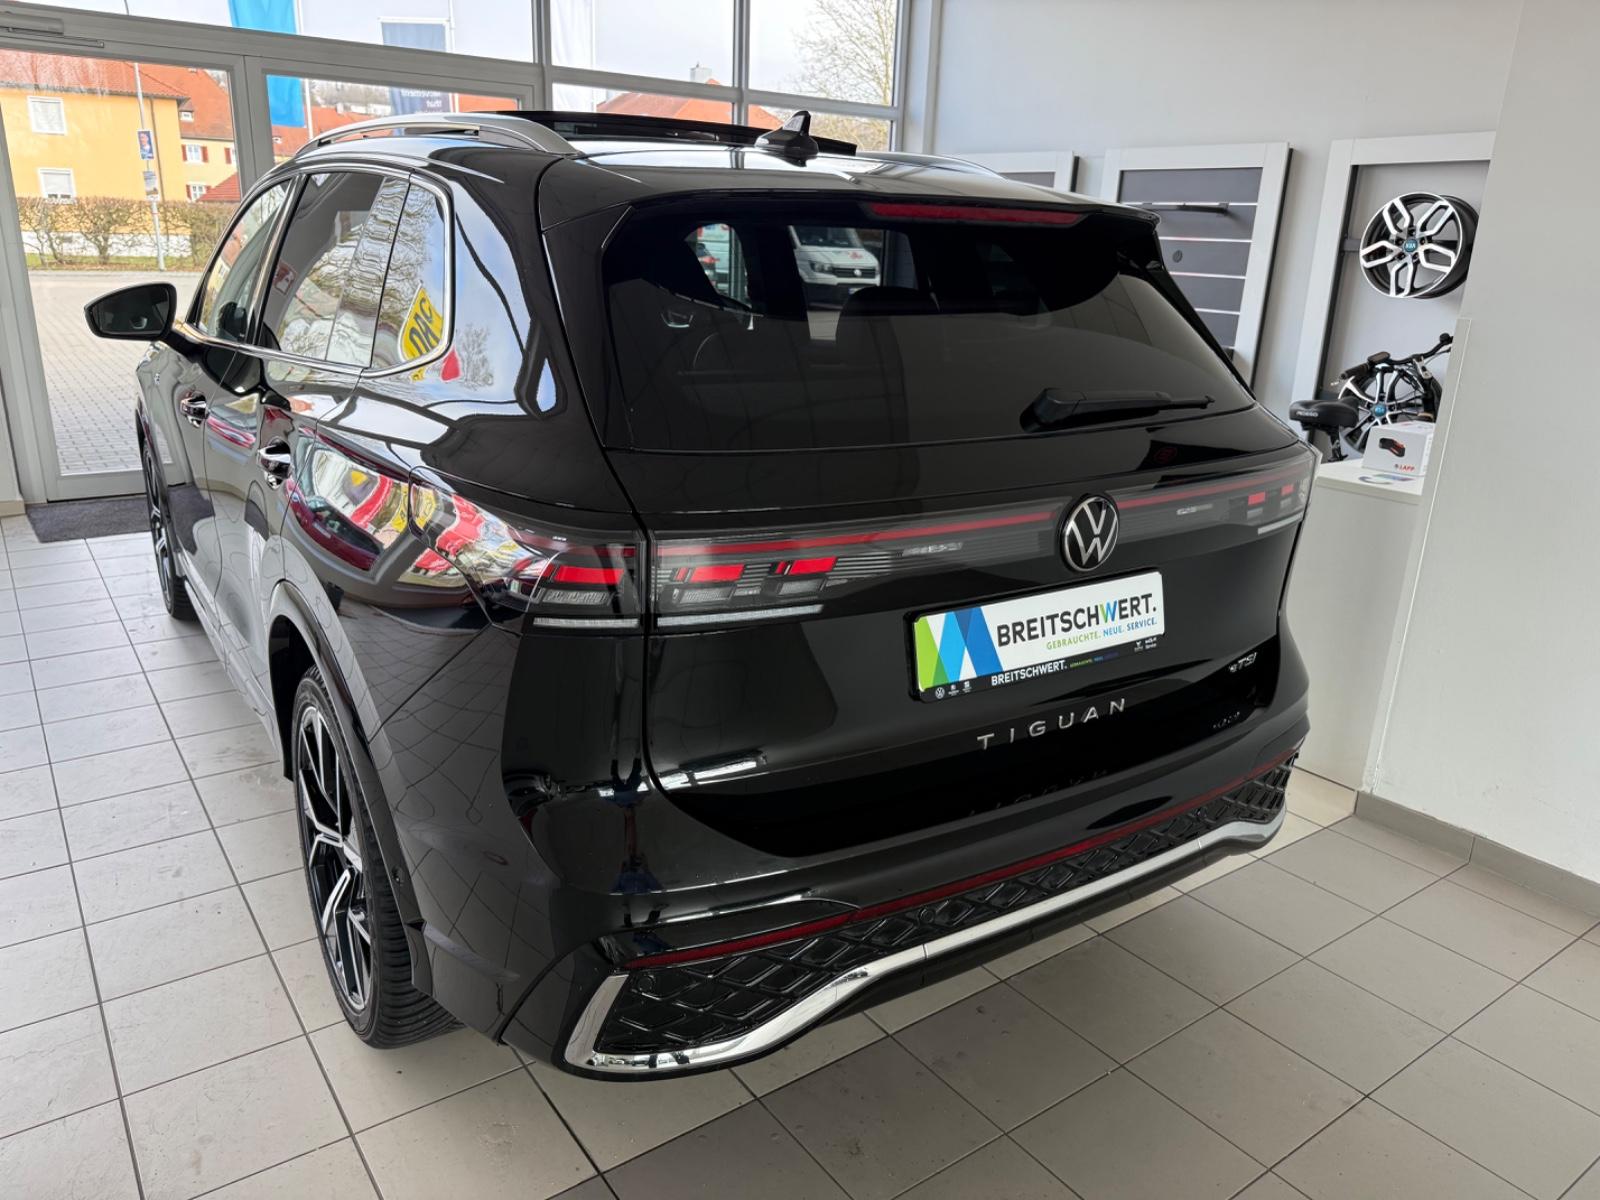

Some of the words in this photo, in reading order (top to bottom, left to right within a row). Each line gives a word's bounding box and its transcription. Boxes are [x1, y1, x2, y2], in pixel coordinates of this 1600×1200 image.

[997, 593, 1157, 647] BREITSCHWERT.
[1046, 632, 1101, 650] GEBRAUCHTE.
[1103, 625, 1125, 637] NEUE.
[1126, 617, 1157, 632] SERVICE.
[991, 660, 1067, 686] BREITSCHWERT.
[976, 698, 1125, 750] TIGUAN
